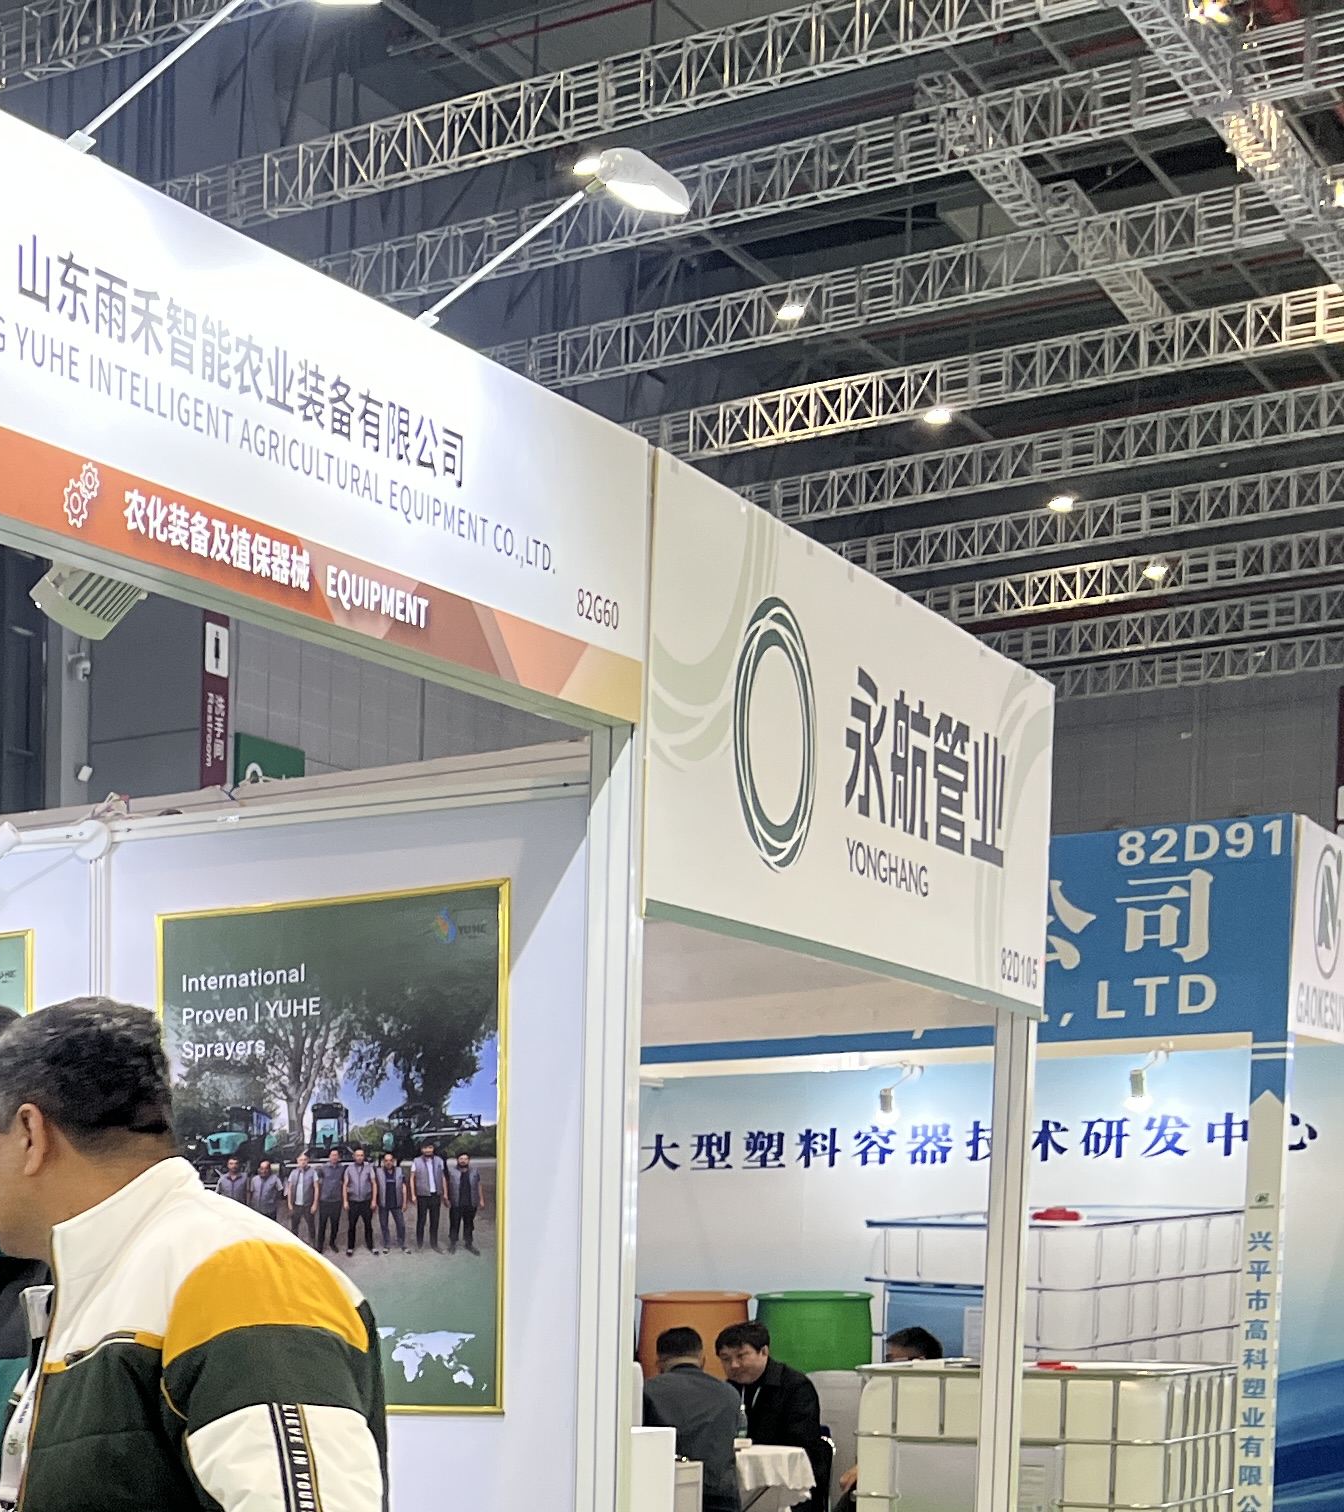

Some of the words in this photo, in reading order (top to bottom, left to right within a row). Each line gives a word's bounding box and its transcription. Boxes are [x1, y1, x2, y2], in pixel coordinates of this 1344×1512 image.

[17, 234, 465, 489] 山东雨禾智能农业装备有限公司
[15, 322, 80, 383] YUHE
[89, 353, 234, 445] INTELLIGENT
[239, 415, 383, 506] AGRICULTURAL
[388, 479, 490, 549] EQUIPMENT
[493, 522, 557, 575] CO.,LTD.
[123, 488, 311, 593] 农化装备及植保器械
[325, 564, 430, 630] EQUIPMENT
[576, 587, 620, 631] 82G60
[844, 665, 1008, 869] 永航管业
[1116, 819, 1284, 867] 82D91
[845, 836, 930, 899] YONGHANG
[182, 963, 306, 993] International
[1000, 946, 1039, 990] 82D105
[182, 1005, 249, 1026] Proven
[265, 996, 322, 1019] YUHE
[181, 1039, 266, 1063] Sprayers
[282, 1404, 304, 1445] LIEVE
[291, 1450, 309, 1465] IN
